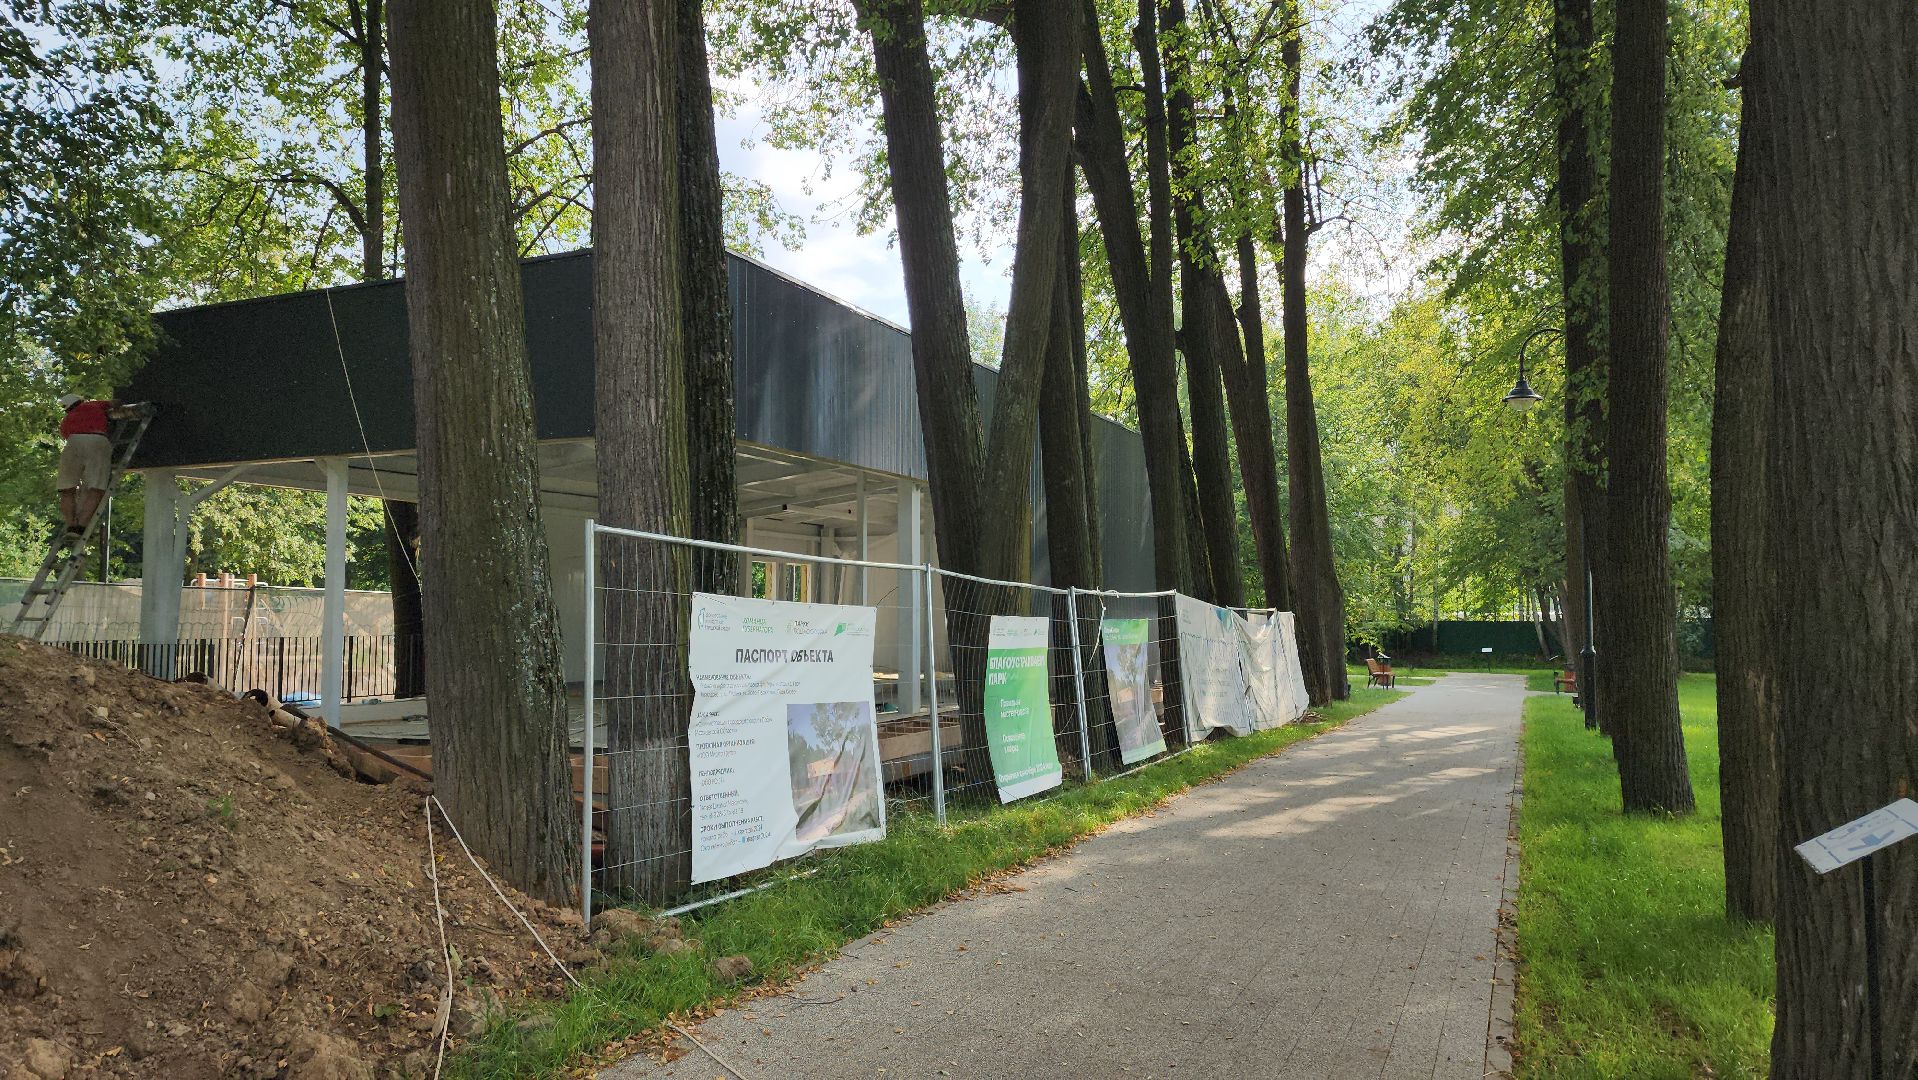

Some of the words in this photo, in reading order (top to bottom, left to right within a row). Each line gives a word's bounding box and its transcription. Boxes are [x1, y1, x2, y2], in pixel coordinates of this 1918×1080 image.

[735, 648, 788, 664] ПАСПОРТ
[790, 649, 834, 663] ОБЪЕКТА
[988, 672, 1008, 686] ПАРК
